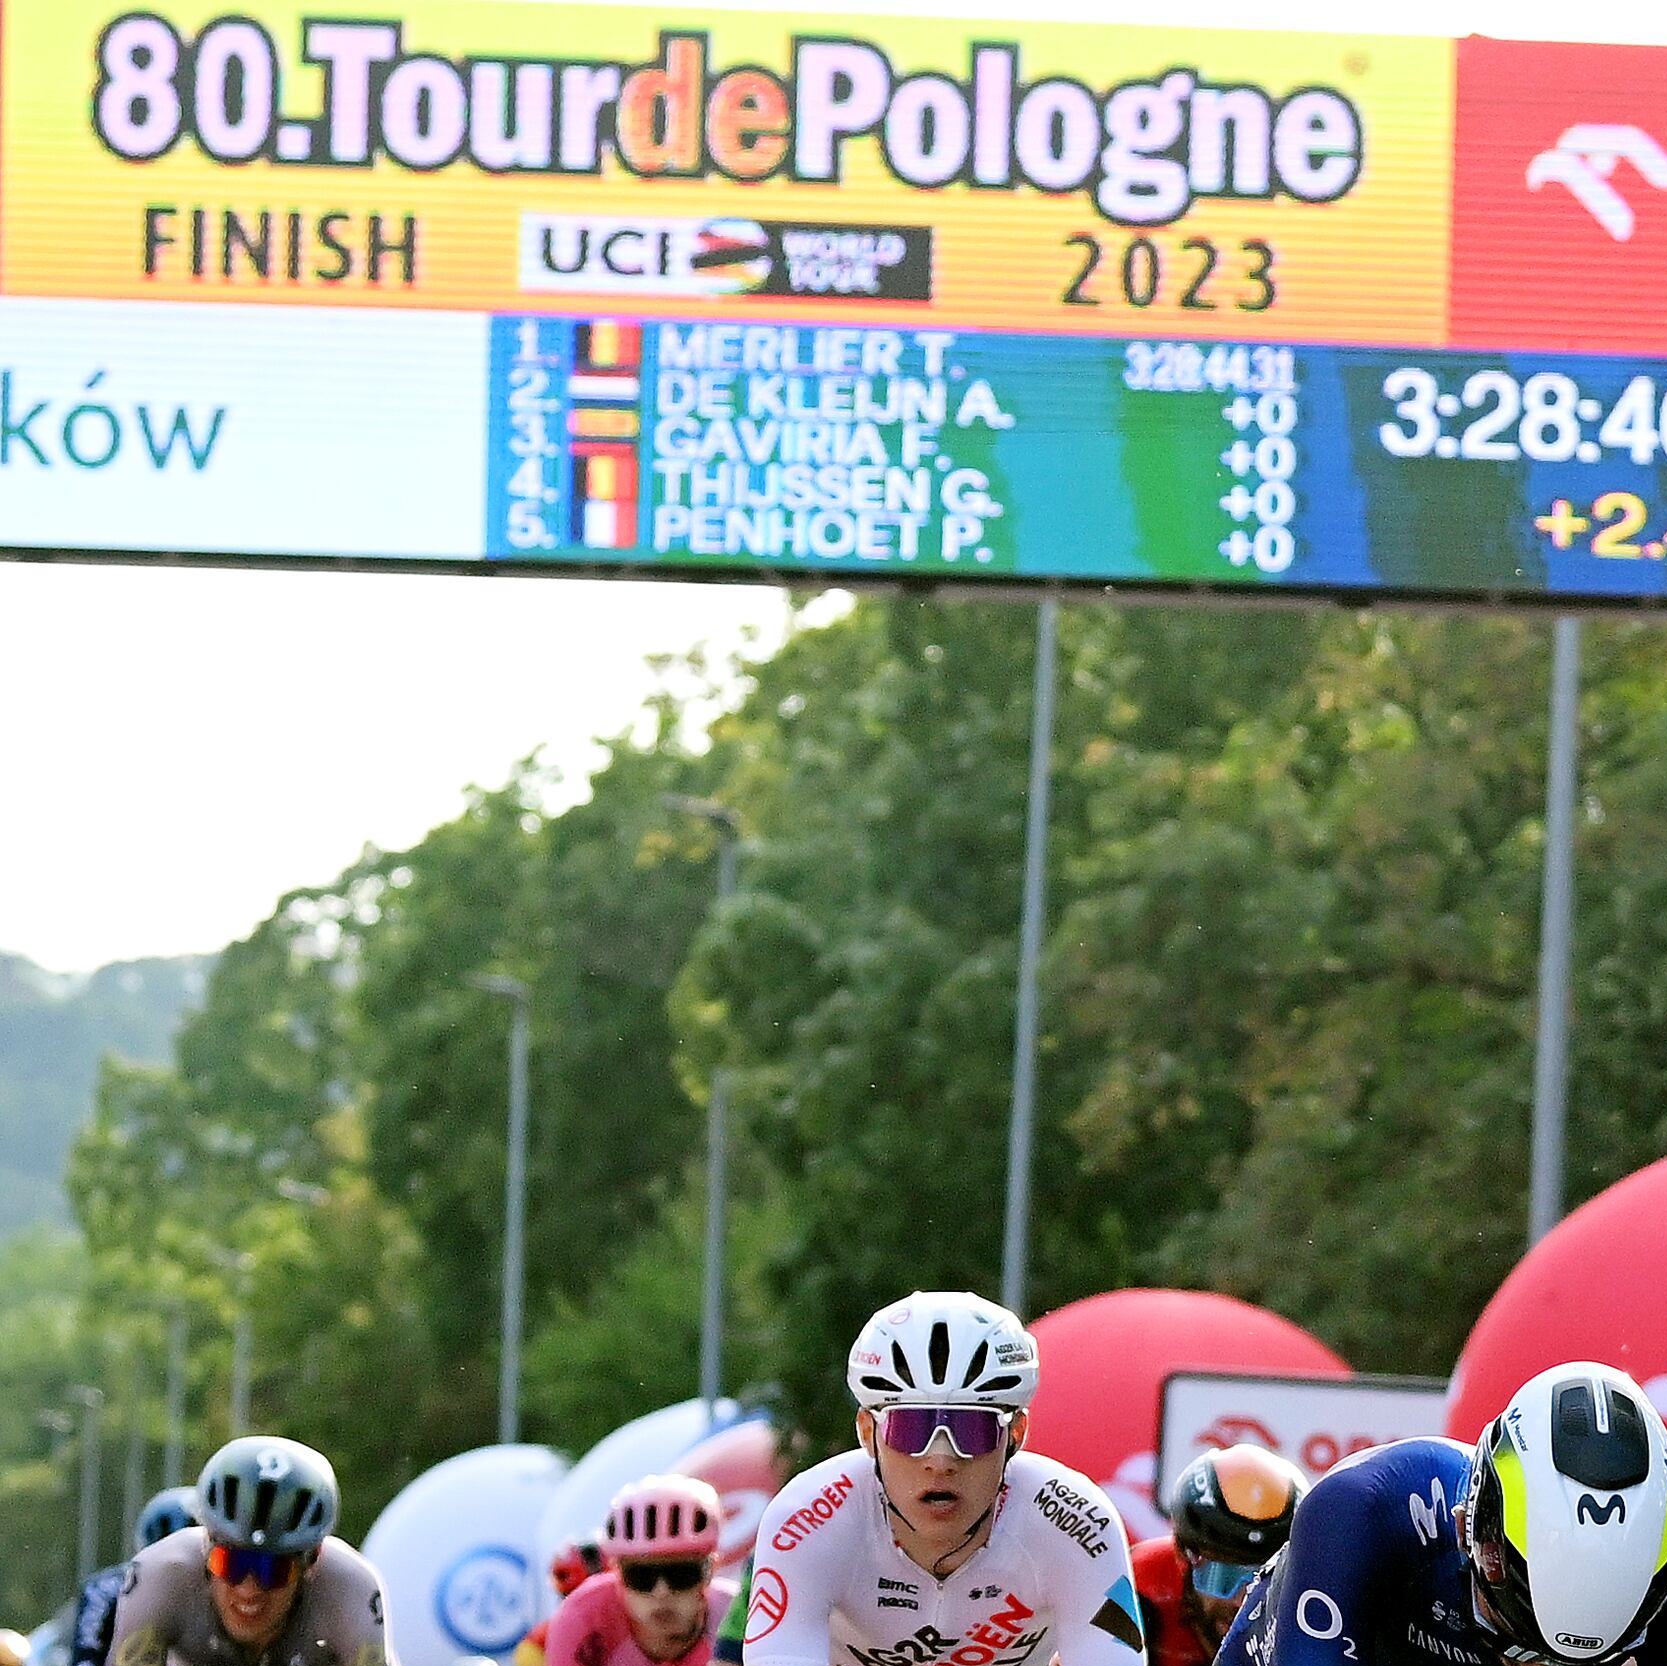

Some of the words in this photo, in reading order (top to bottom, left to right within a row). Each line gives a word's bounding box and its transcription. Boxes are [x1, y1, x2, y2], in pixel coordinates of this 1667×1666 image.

[144, 205, 416, 285] FINISH
[541, 228, 669, 275] UCI
[1062, 234, 1276, 310] 2023
[657, 323, 903, 372] MERLIER
[914, 332, 966, 380] T.
[657, 370, 734, 418] DE
[955, 380, 1015, 428] A.
[1221, 391, 1298, 436] +0
[654, 416, 887, 466] GAVIRIA
[903, 425, 952, 471] F.
[1219, 434, 1297, 482] +0
[941, 469, 1003, 517] G.
[1218, 480, 1296, 526] +0
[654, 506, 928, 557] PENHOET
[941, 515, 993, 563] P.
[1217, 525, 1295, 573] +0
[773, 1474, 854, 1552] CITROËN
[1033, 1489, 1108, 1559] MONDIALE
[1045, 1476, 1098, 1520] AG2R
[1089, 1505, 1112, 1531] LA
[878, 1577, 919, 1595] BMC
[1408, 1623, 1482, 1664] CANYON
[1561, 1636, 1599, 1648] ABUS
